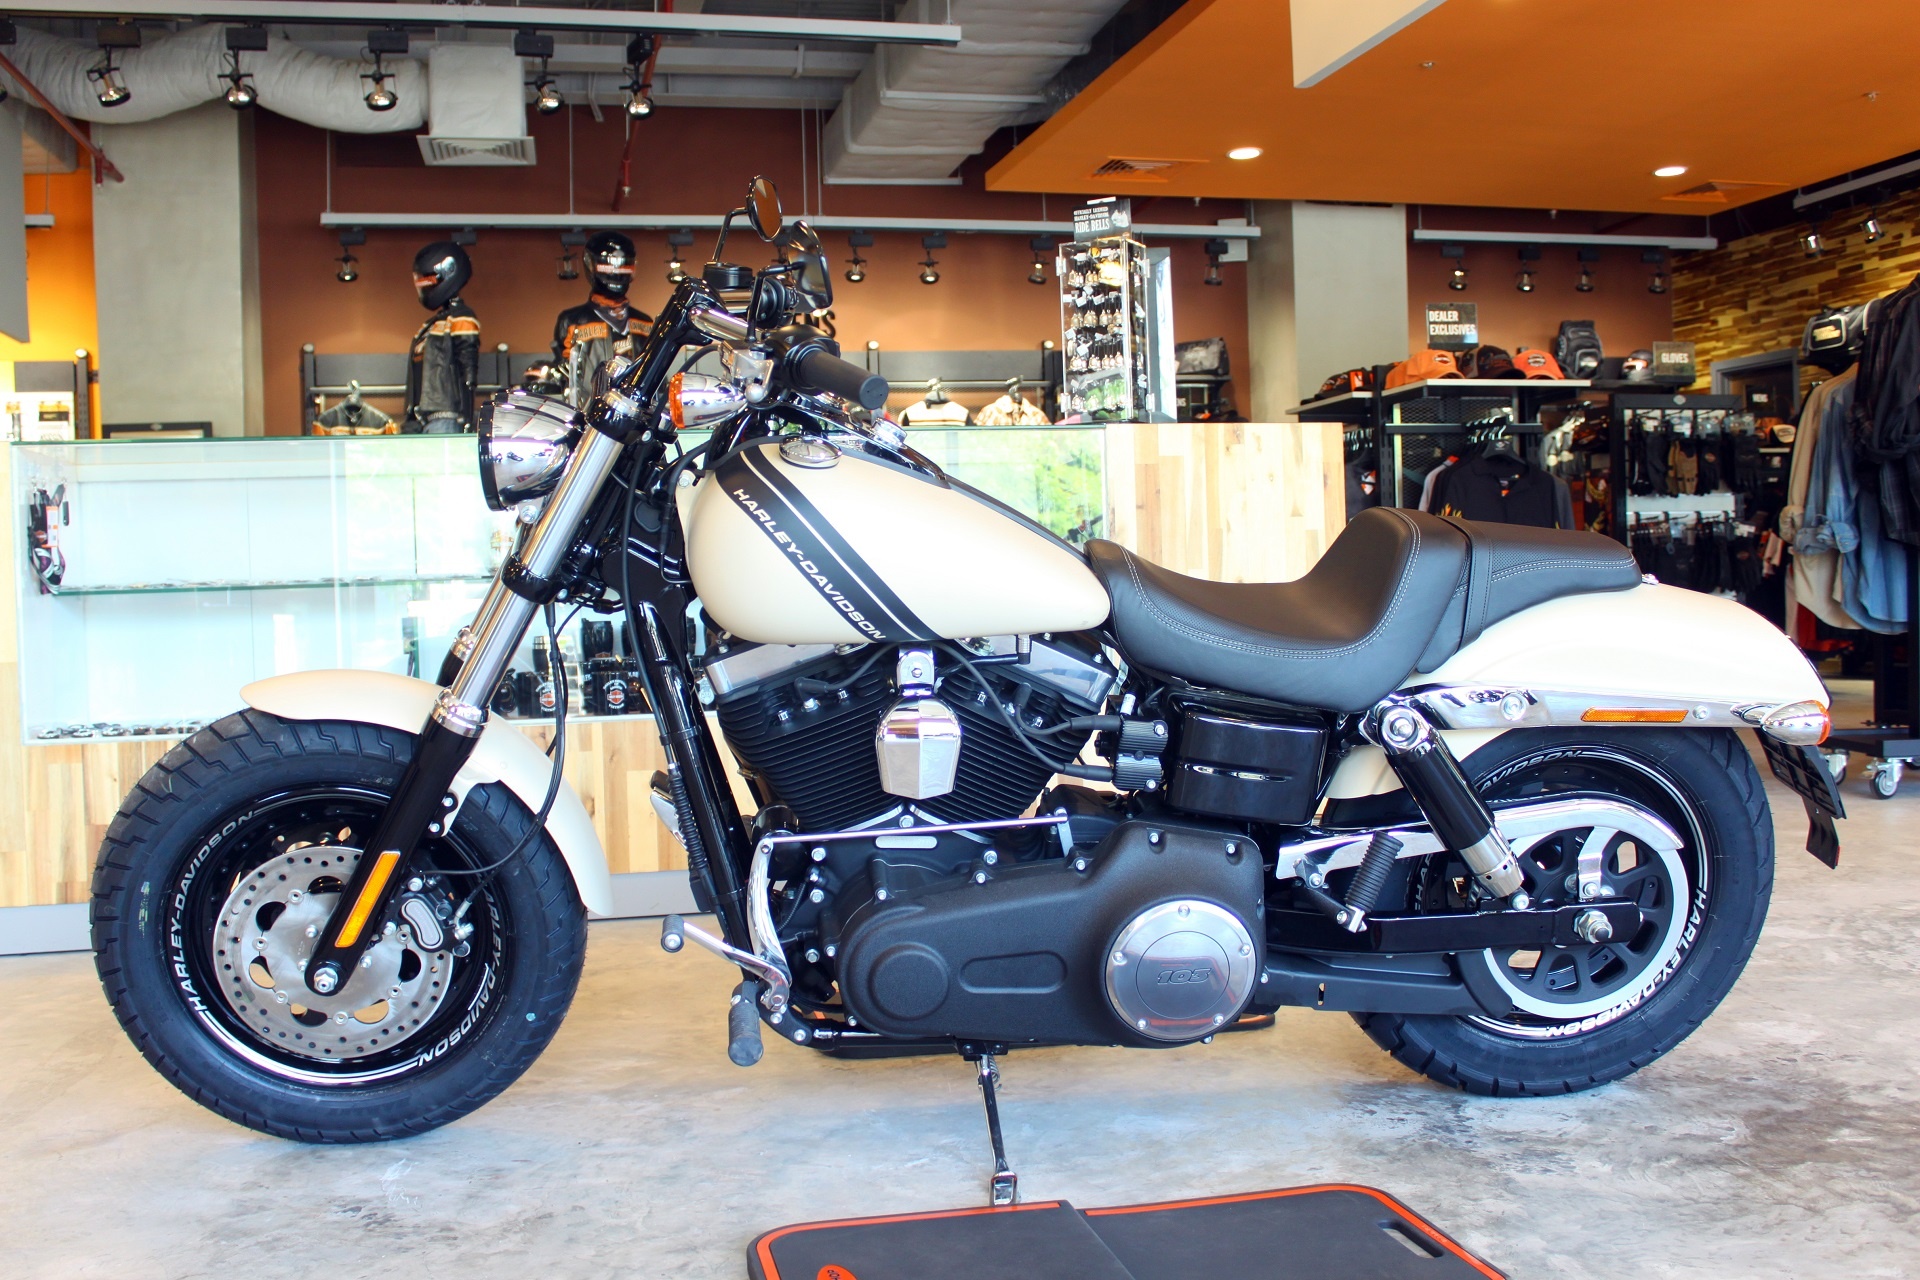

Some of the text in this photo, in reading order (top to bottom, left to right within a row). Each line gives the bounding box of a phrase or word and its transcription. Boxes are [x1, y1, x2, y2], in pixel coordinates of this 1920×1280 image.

[1075, 218, 1110, 233] RIDE BELLS
[1429, 310, 1459, 322] DEALER
[1429, 324, 1476, 336] EXCLUSIVES
[1661, 352, 1689, 363] GLOVES
[733, 488, 886, 640] HARLEY-DAVIDSON
[171, 810, 254, 1011] HARLEY-DAVIDSON
[418, 885, 502, 1067] ARLEY-DAVIDSON
[1545, 887, 1707, 1038] HARLEY-DAVIDSON
